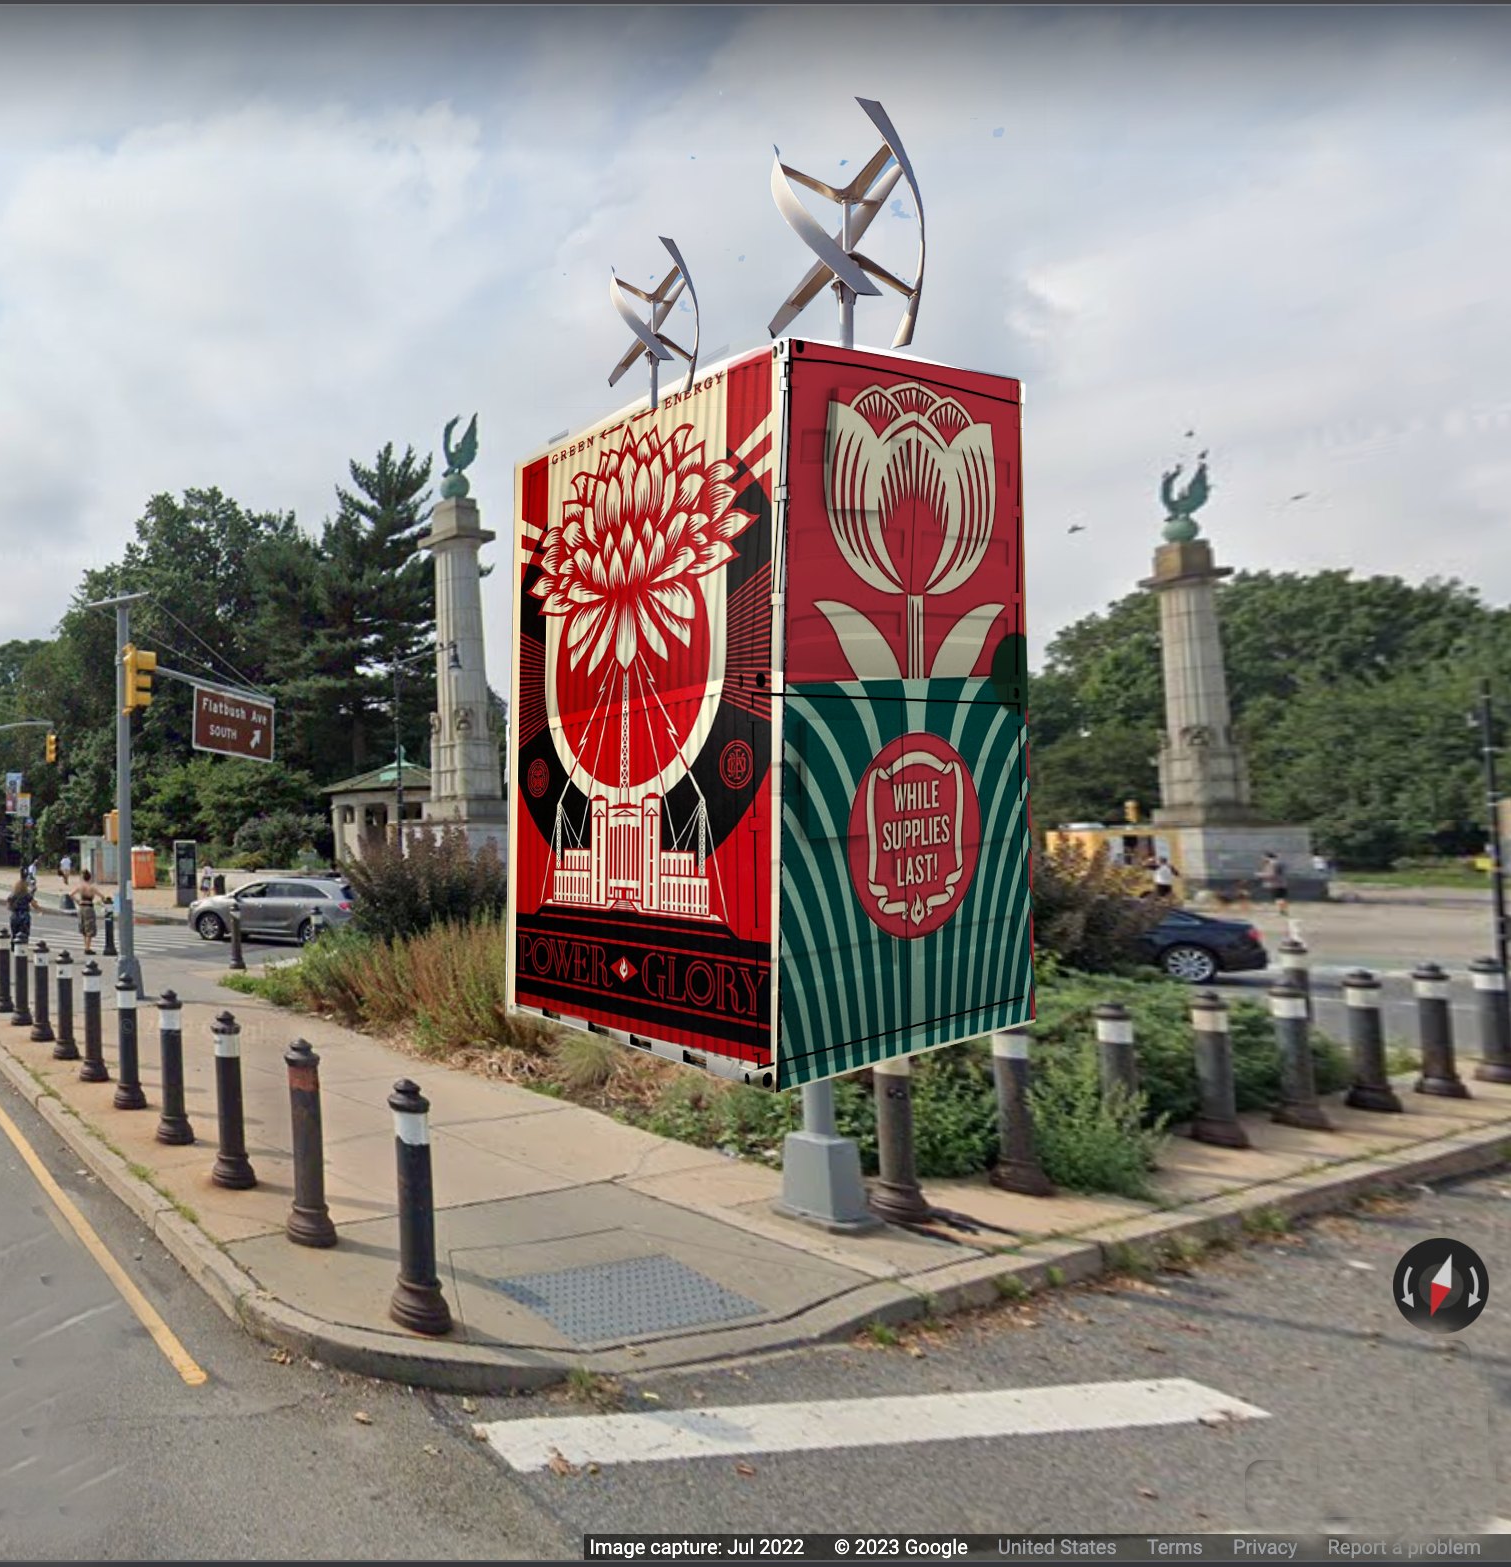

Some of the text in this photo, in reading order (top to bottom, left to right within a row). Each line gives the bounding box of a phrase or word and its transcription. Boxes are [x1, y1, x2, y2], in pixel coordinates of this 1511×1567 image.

[551, 371, 724, 465] GREEN ENERGY
[202, 697, 267, 725] Flatbush Ave
[209, 724, 237, 740] SOUTH
[893, 780, 940, 813] WHILE
[882, 815, 950, 852] SUPPLIES
[896, 852, 938, 887] LAST!
[518, 934, 769, 1017] POWER GLORY
